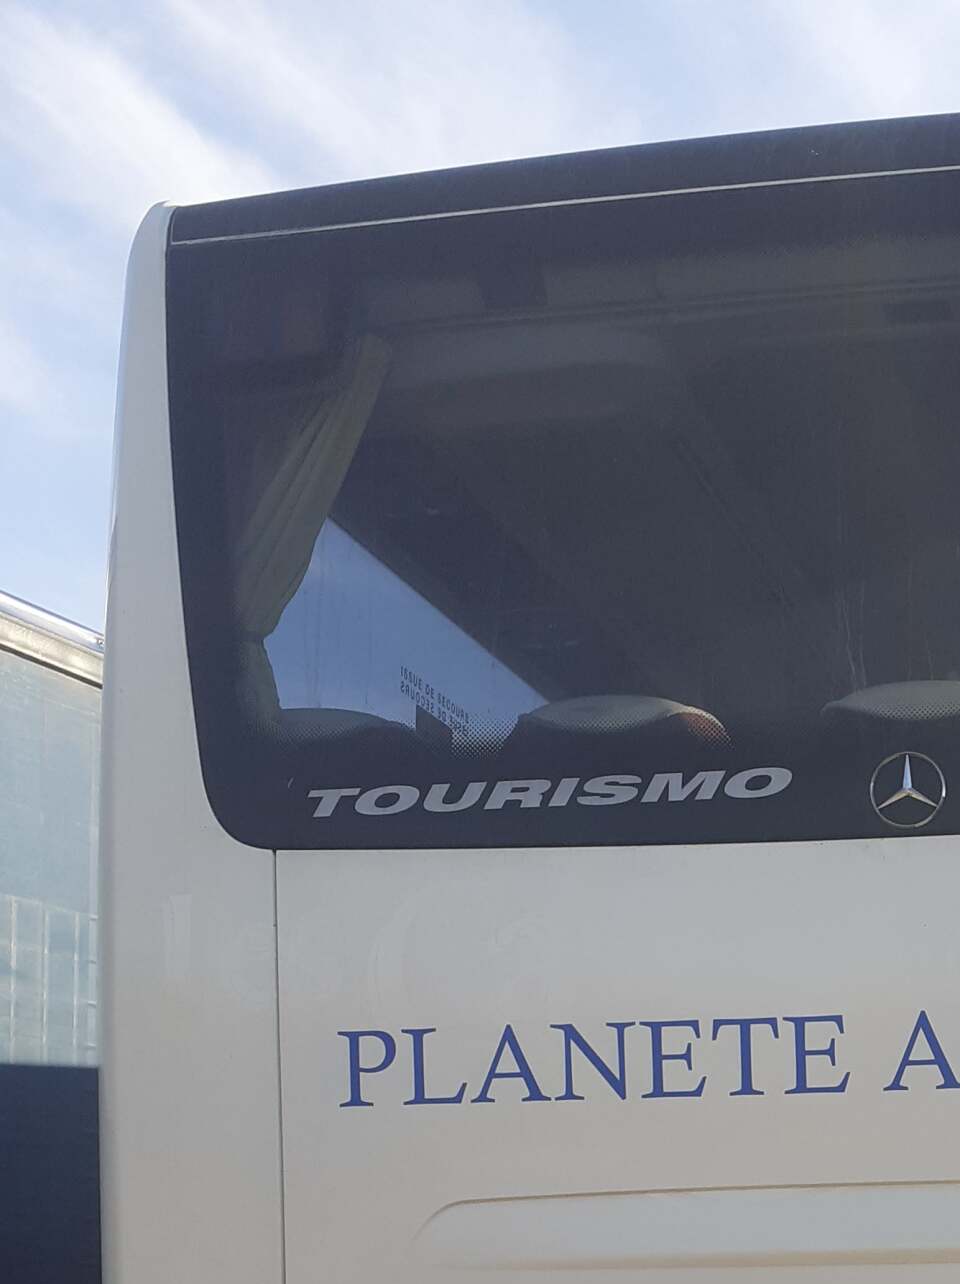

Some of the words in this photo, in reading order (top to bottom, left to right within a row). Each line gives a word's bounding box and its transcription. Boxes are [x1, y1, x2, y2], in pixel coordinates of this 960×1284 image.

[425, 683, 435, 700] DE
[308, 767, 793, 818] TOURISMO
[338, 1014, 851, 1107] PLANETE
